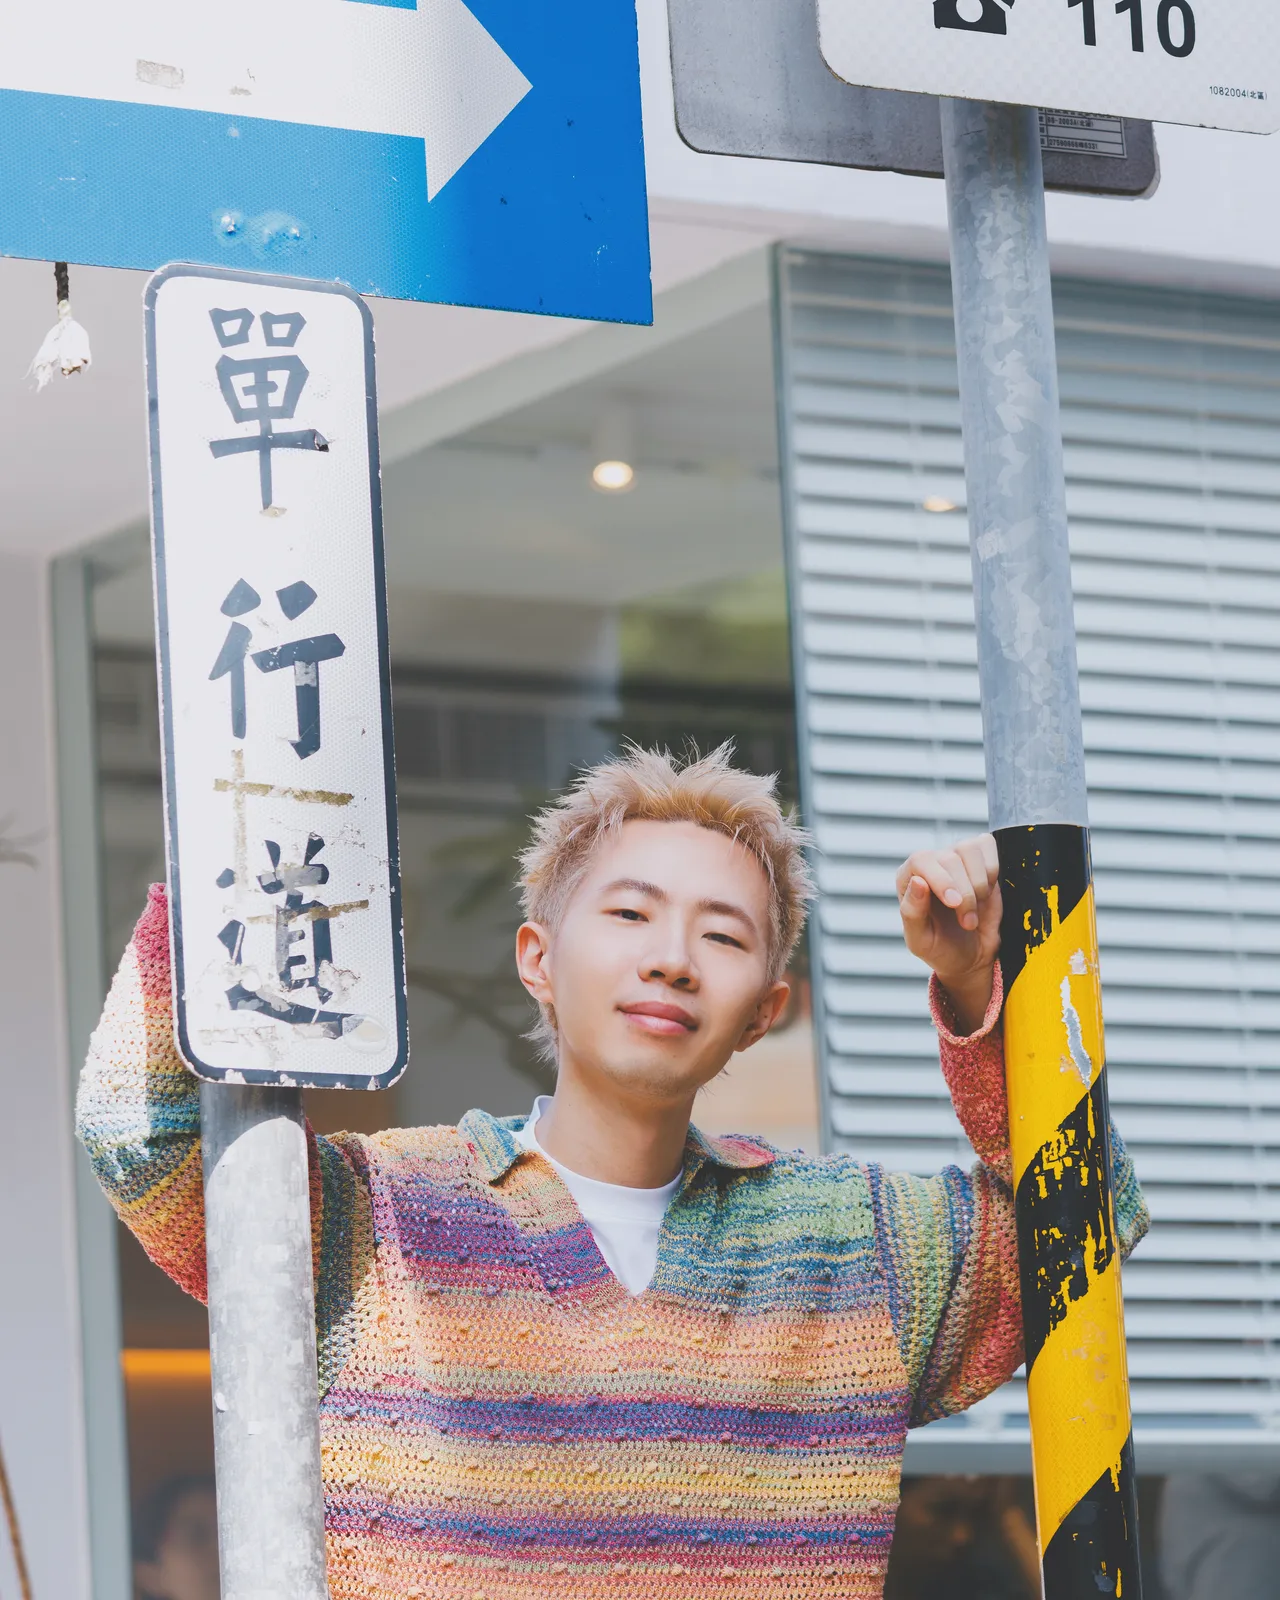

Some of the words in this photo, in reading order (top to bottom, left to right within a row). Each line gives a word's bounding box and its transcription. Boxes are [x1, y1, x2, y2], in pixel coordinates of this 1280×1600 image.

[1067, 0, 1196, 58] 110
[208, 307, 364, 1042] 單行道
